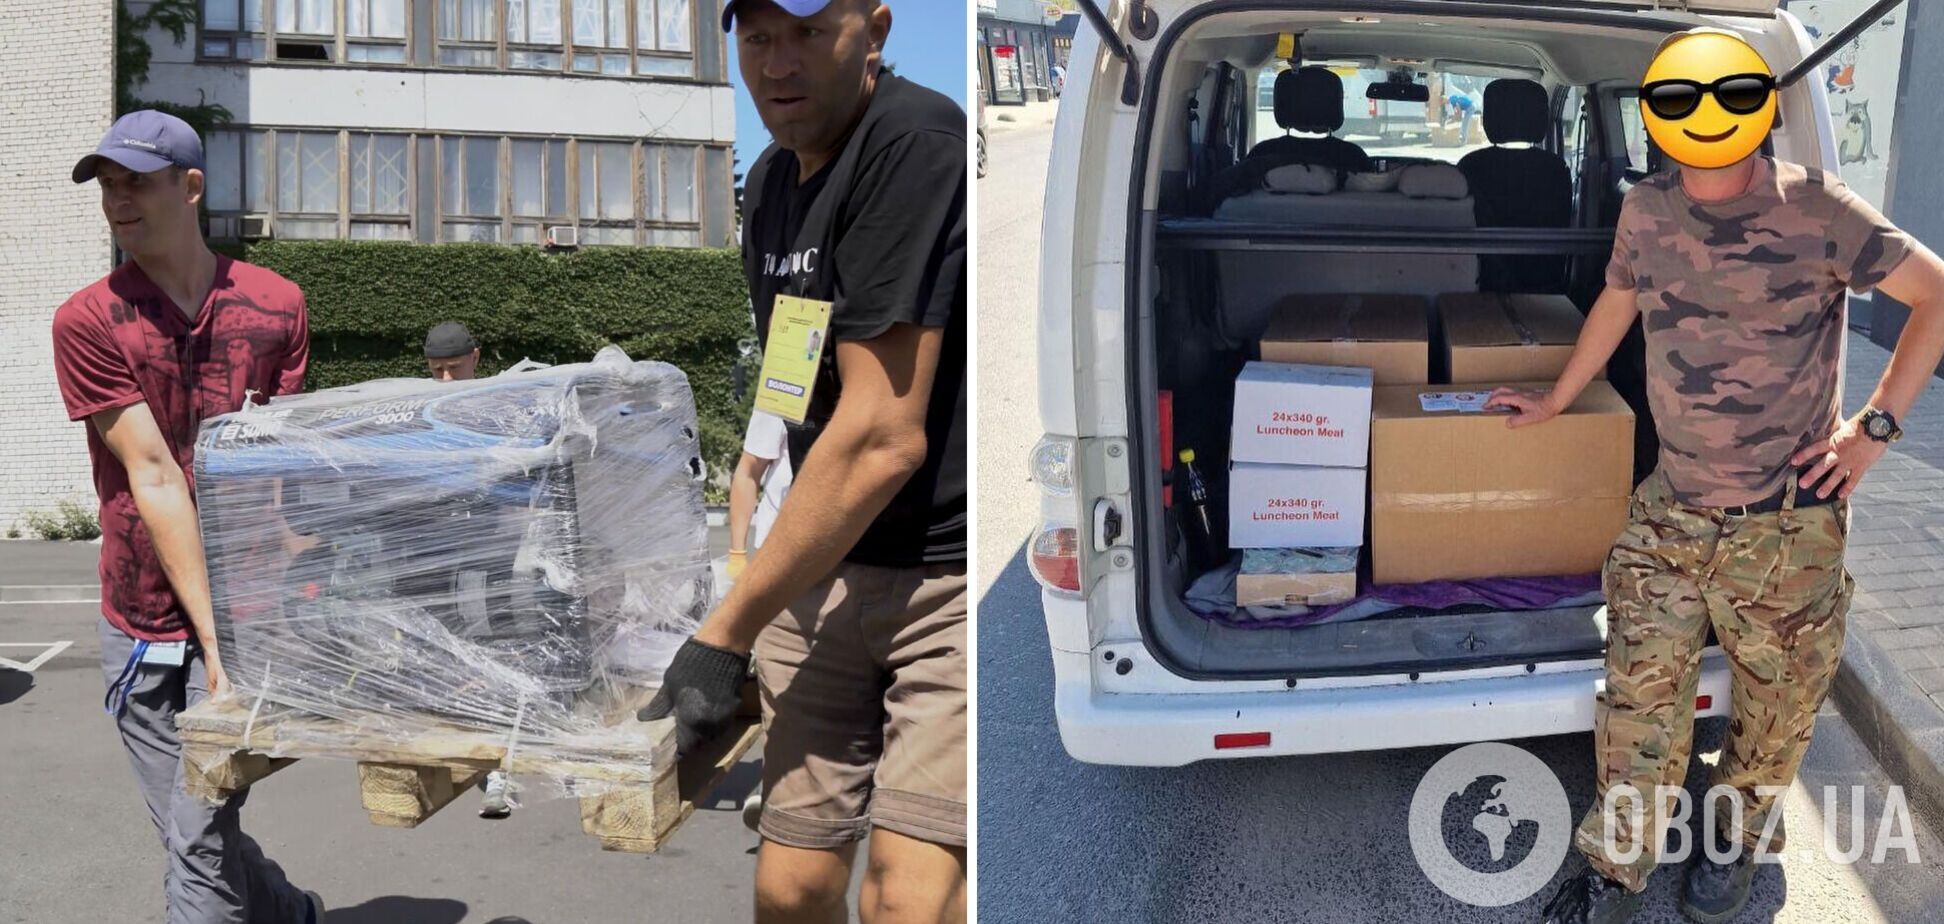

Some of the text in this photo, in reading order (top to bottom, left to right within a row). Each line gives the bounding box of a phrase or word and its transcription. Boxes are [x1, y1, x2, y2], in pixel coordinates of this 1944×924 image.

[375, 411, 415, 425] 3000
[1272, 412, 1330, 426] 24x340 gr.
[1256, 424, 1344, 438] Luncheon Meat
[1268, 498, 1325, 509] 24x340 gr.
[1252, 510, 1340, 521] Luncheon Meat
